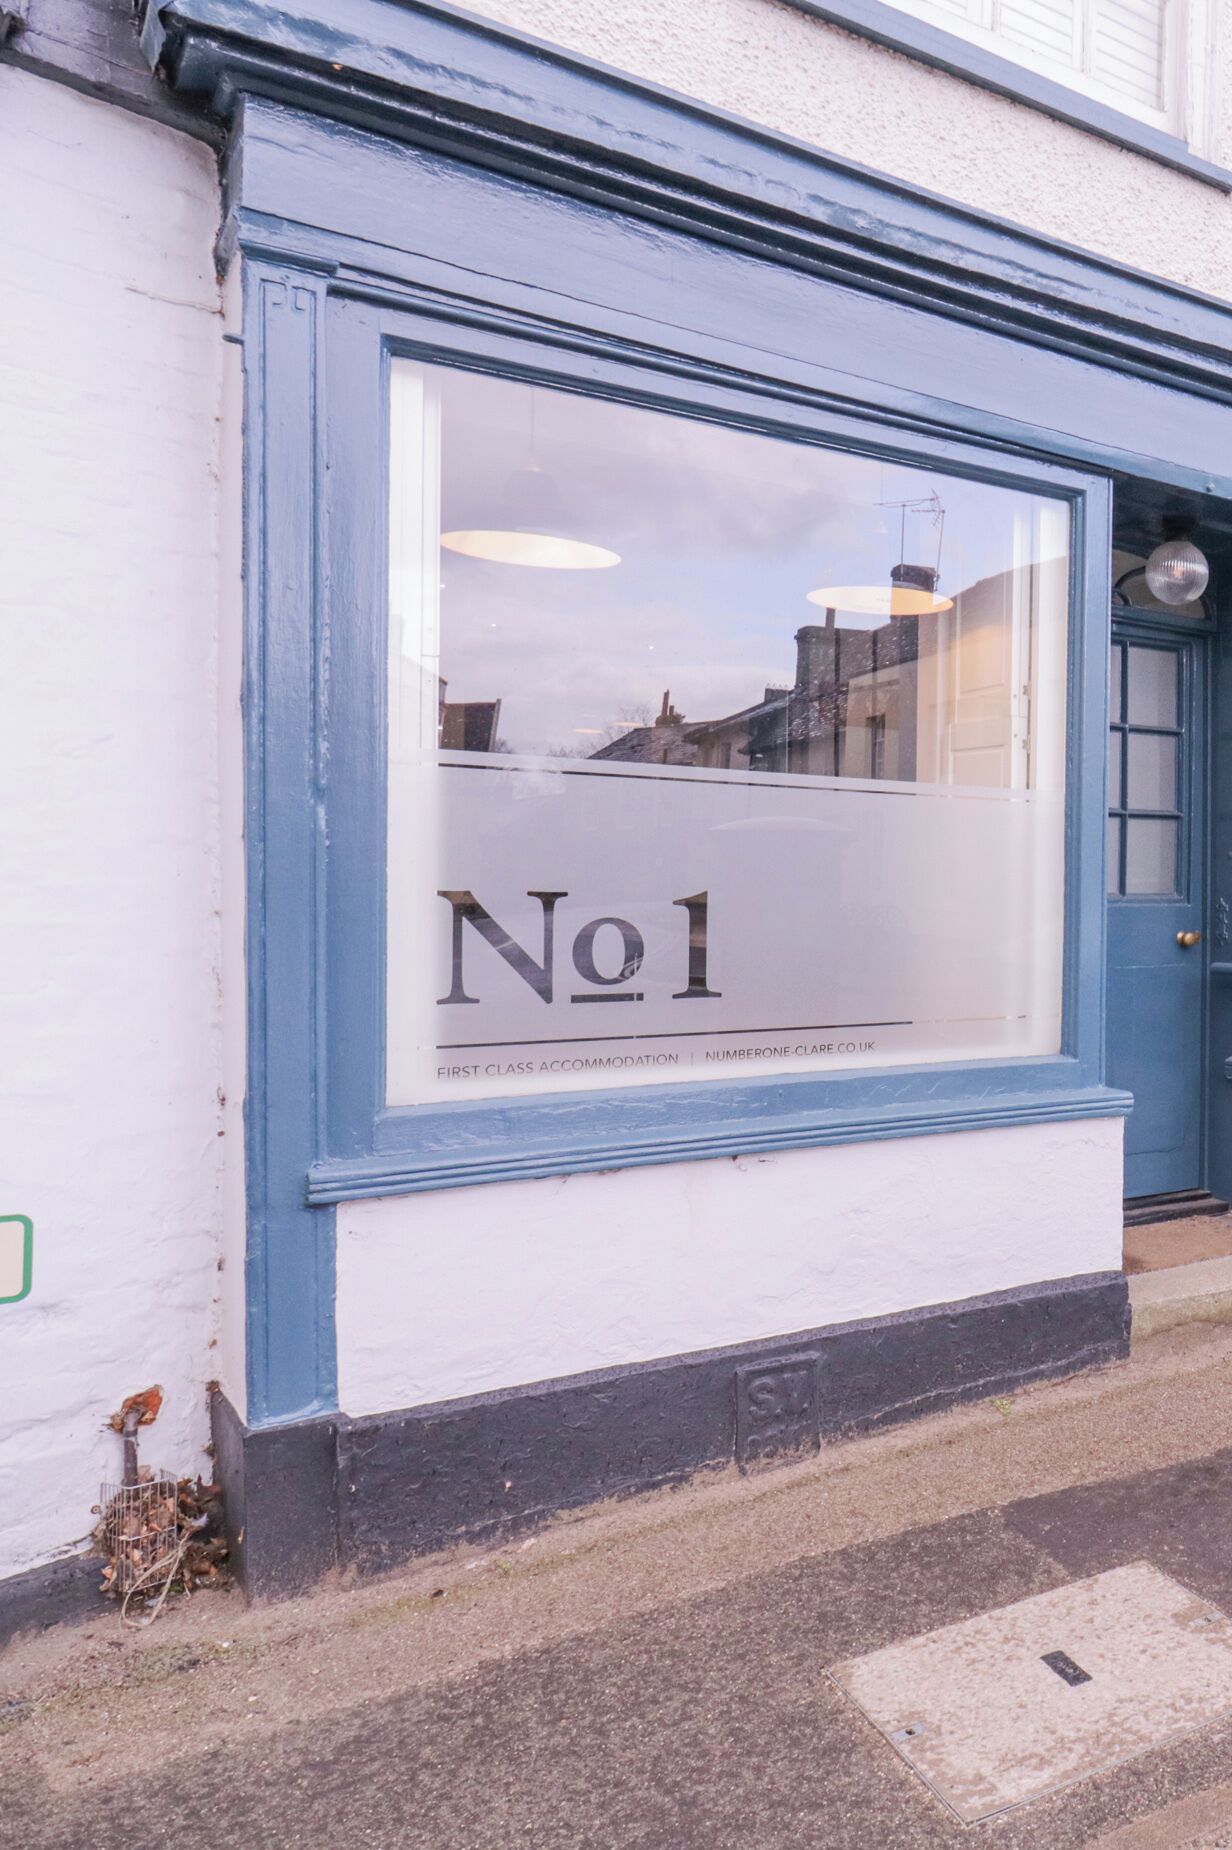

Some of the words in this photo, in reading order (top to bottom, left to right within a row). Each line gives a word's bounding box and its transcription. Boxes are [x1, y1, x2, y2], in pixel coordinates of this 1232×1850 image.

[437, 1064, 480, 1079] FIRST
[485, 1060, 534, 1076] CLASS
[539, 1053, 679, 1073] ACCOMMODATION
[705, 1041, 876, 1062] NUMBERONE-CLARE.CO.UK
